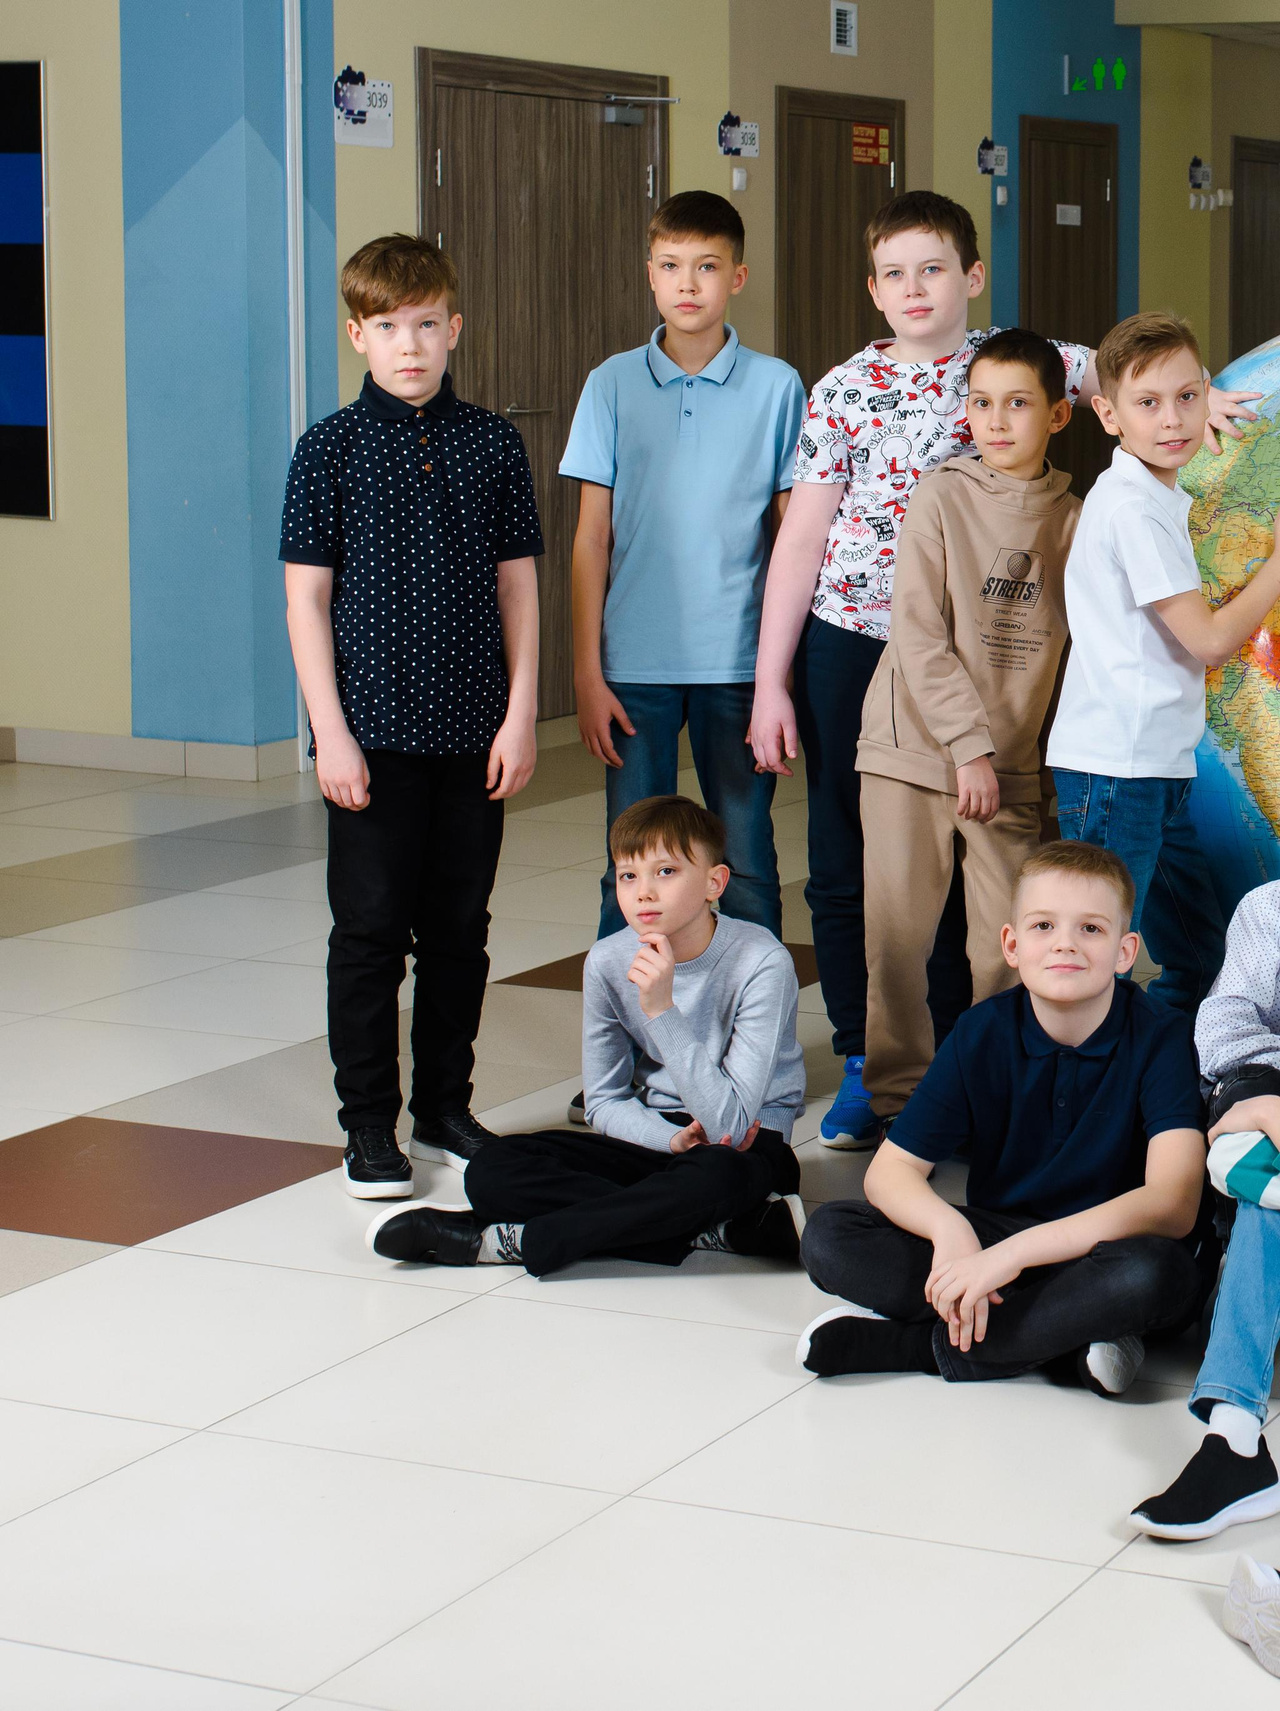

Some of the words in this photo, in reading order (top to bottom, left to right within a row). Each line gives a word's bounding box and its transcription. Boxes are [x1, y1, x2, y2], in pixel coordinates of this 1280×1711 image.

[366, 91, 388, 108] 3039
[741, 132, 756, 146] 3038
[881, 523, 892, 531] ME
[878, 532, 894, 540] GIVE
[982, 577, 1035, 600] STREETS
[995, 608, 1012, 616] STREET
[994, 622, 1022, 630] URBAN
[1013, 638, 1043, 646] GENERATION
